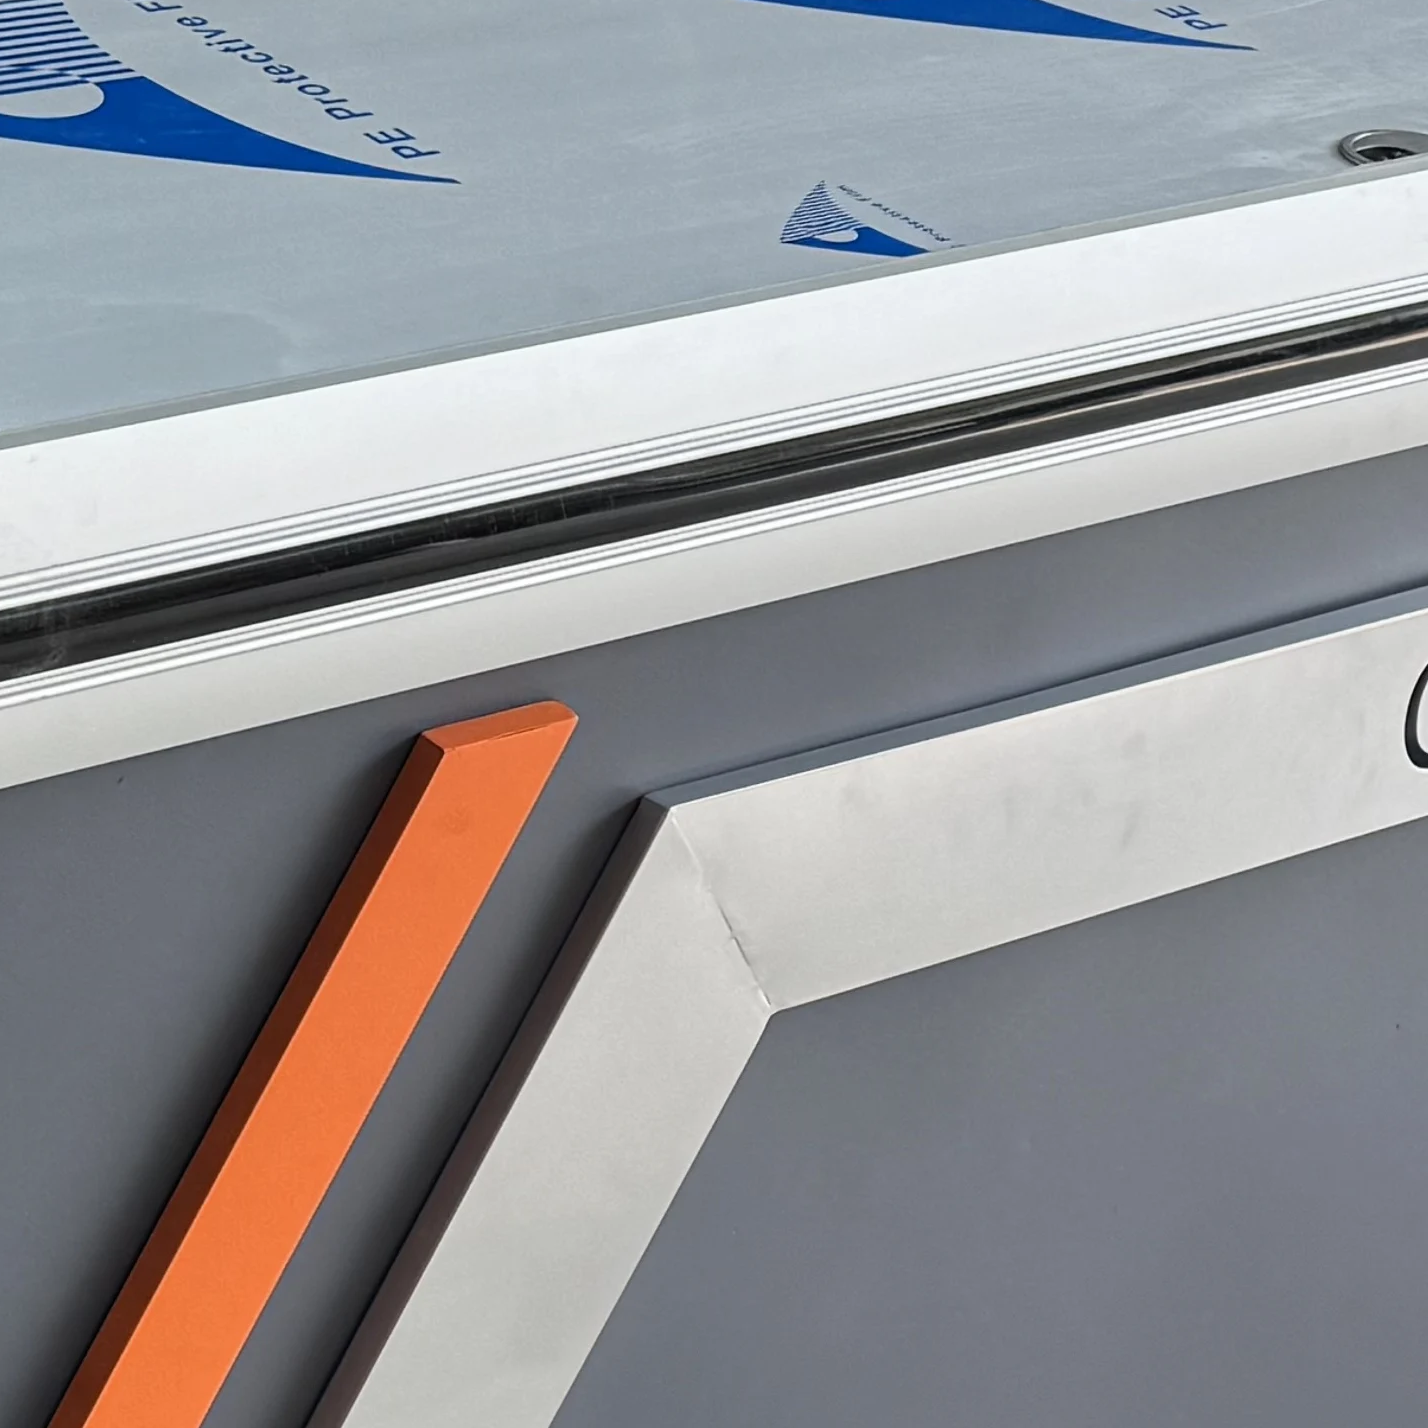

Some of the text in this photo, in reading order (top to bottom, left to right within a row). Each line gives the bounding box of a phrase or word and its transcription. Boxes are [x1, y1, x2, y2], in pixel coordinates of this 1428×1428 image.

[1154, 4, 1228, 31] PE
[176, 15, 374, 121] Protective
[363, 127, 441, 160] PE
